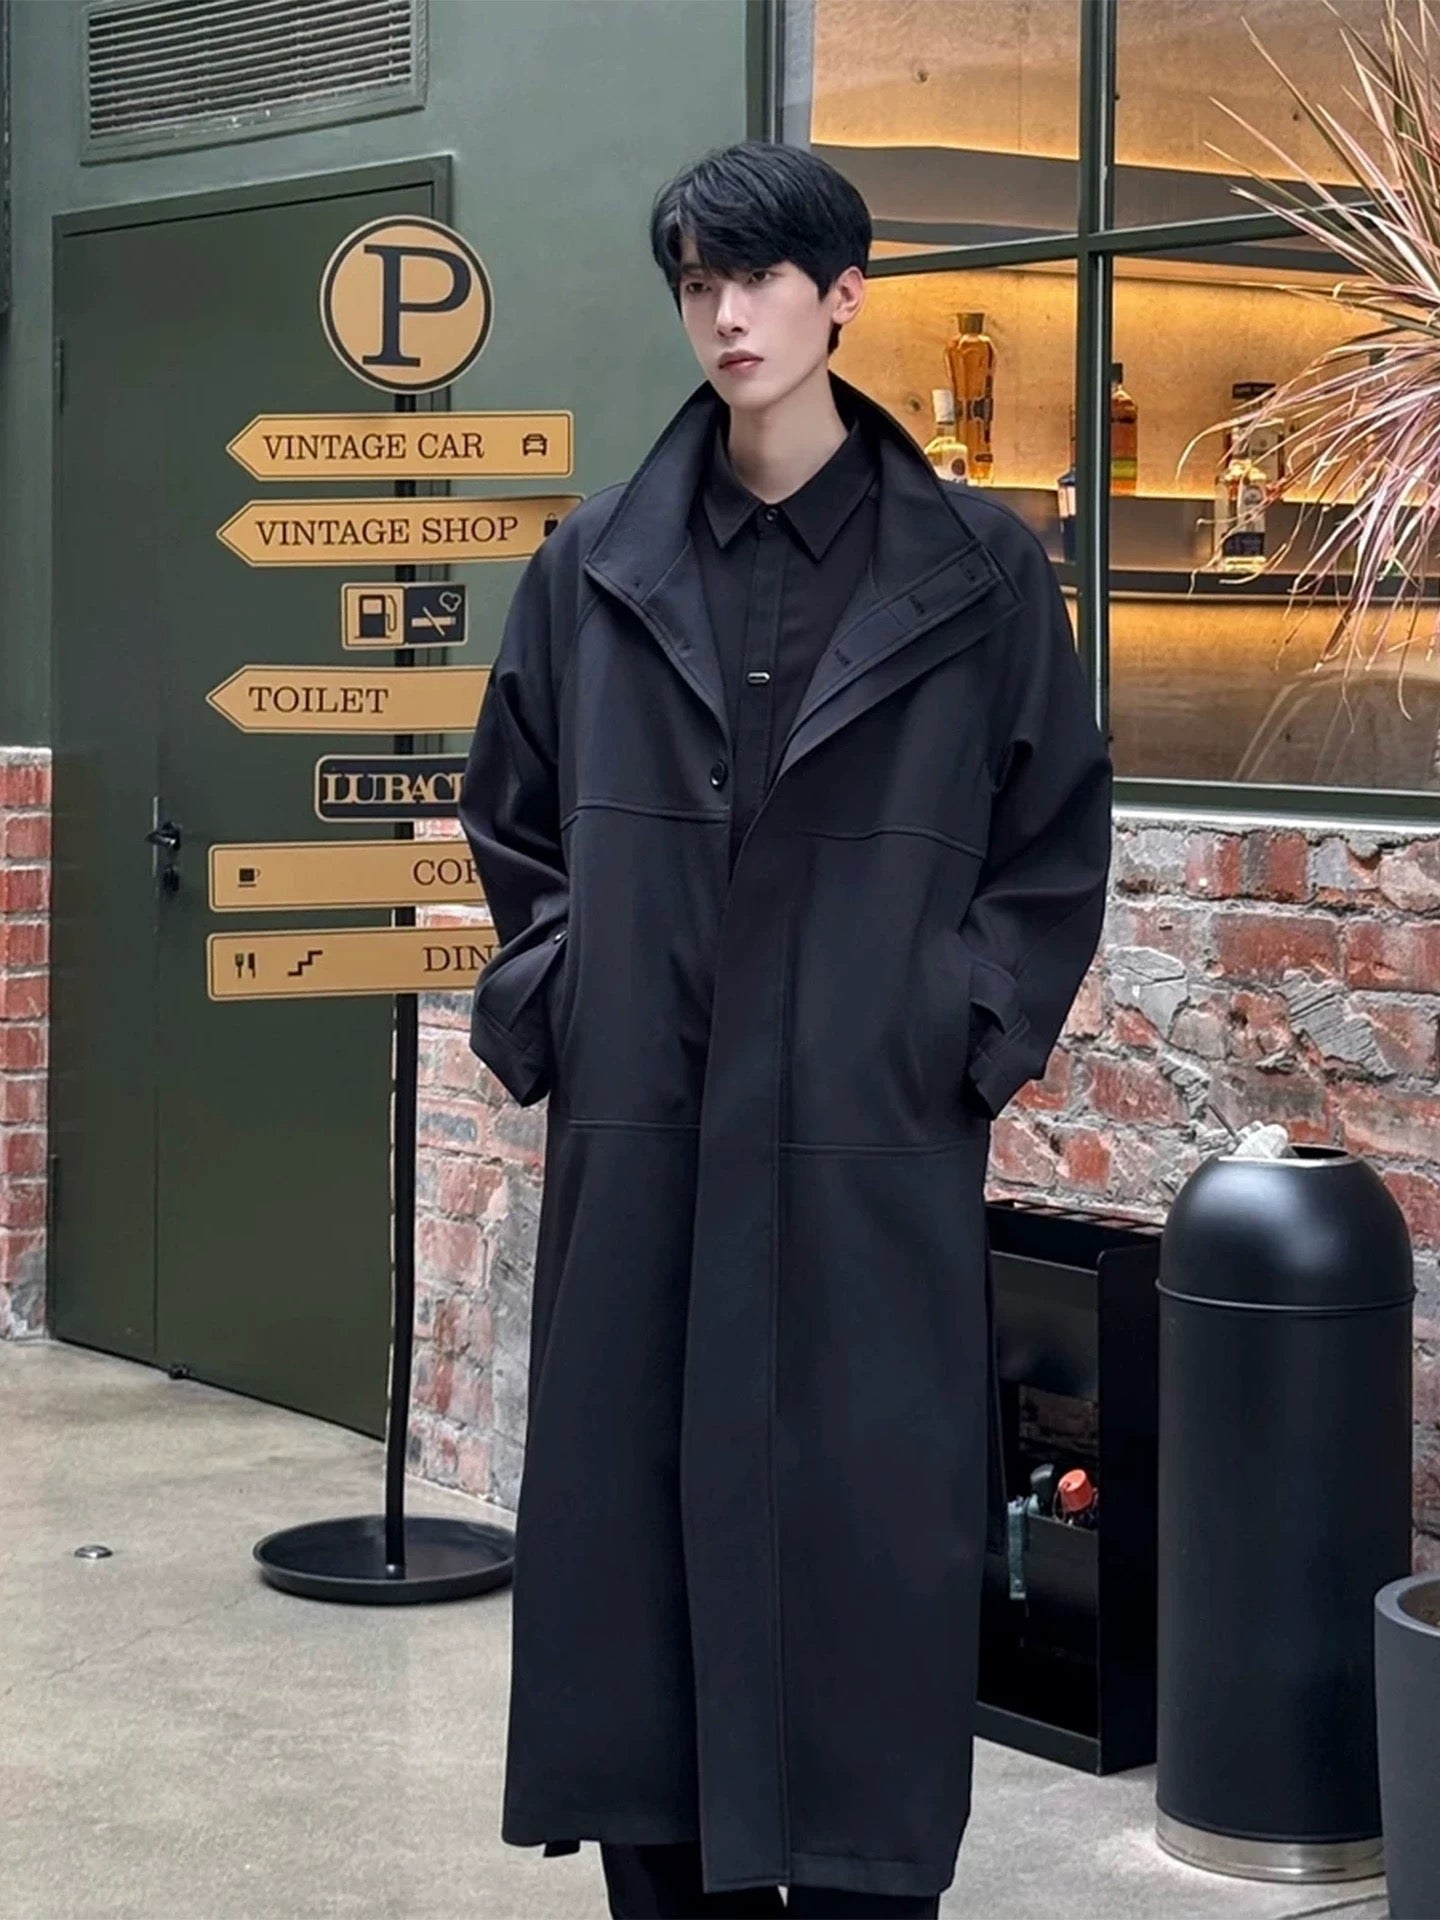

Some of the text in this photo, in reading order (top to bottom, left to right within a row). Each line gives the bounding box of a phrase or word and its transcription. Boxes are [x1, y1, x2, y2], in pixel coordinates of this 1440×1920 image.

[362, 244, 472, 367] P
[263, 433, 485, 461] VINTAGE CAR
[255, 517, 518, 546] VINTAGE SHOP
[248, 687, 389, 713] TOILET
[423, 945, 499, 972] DIN
